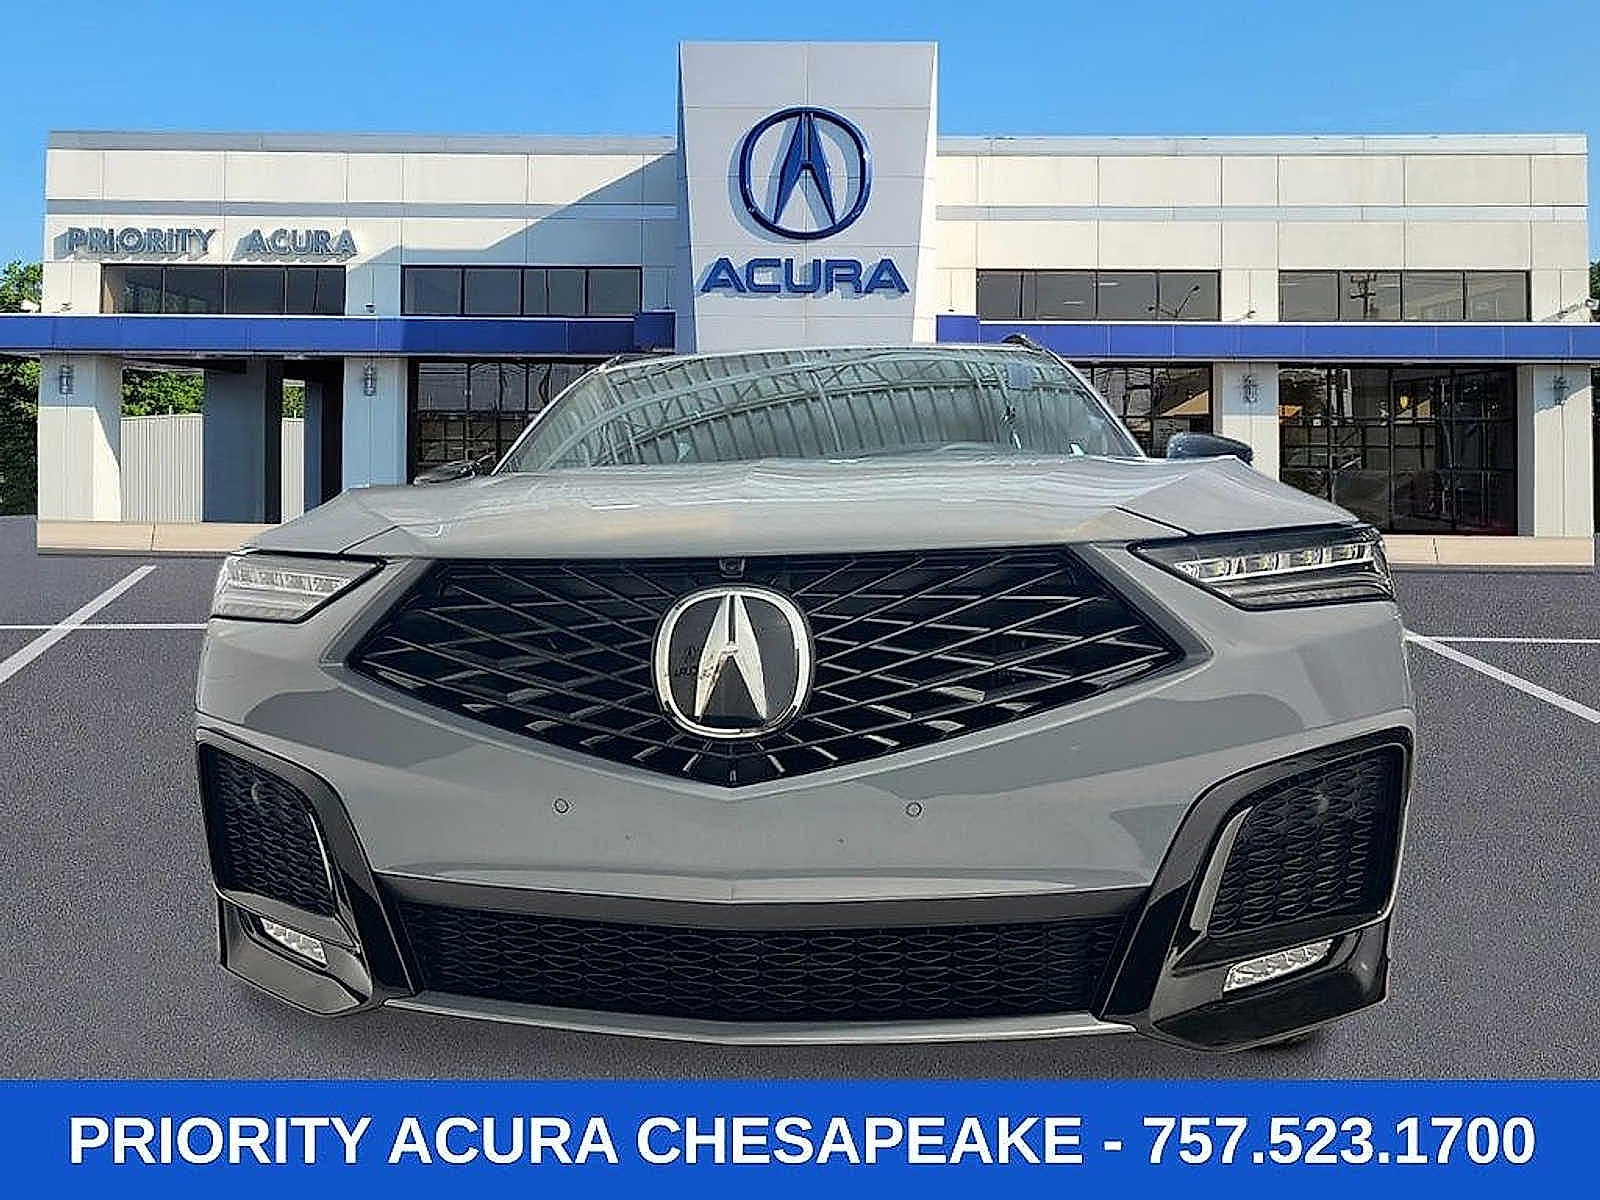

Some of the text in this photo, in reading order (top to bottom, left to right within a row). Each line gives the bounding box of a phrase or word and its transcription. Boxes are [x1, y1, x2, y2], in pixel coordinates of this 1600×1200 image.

[67, 226, 358, 256] PRIORITY ACURA
[700, 257, 909, 294] ACURA
